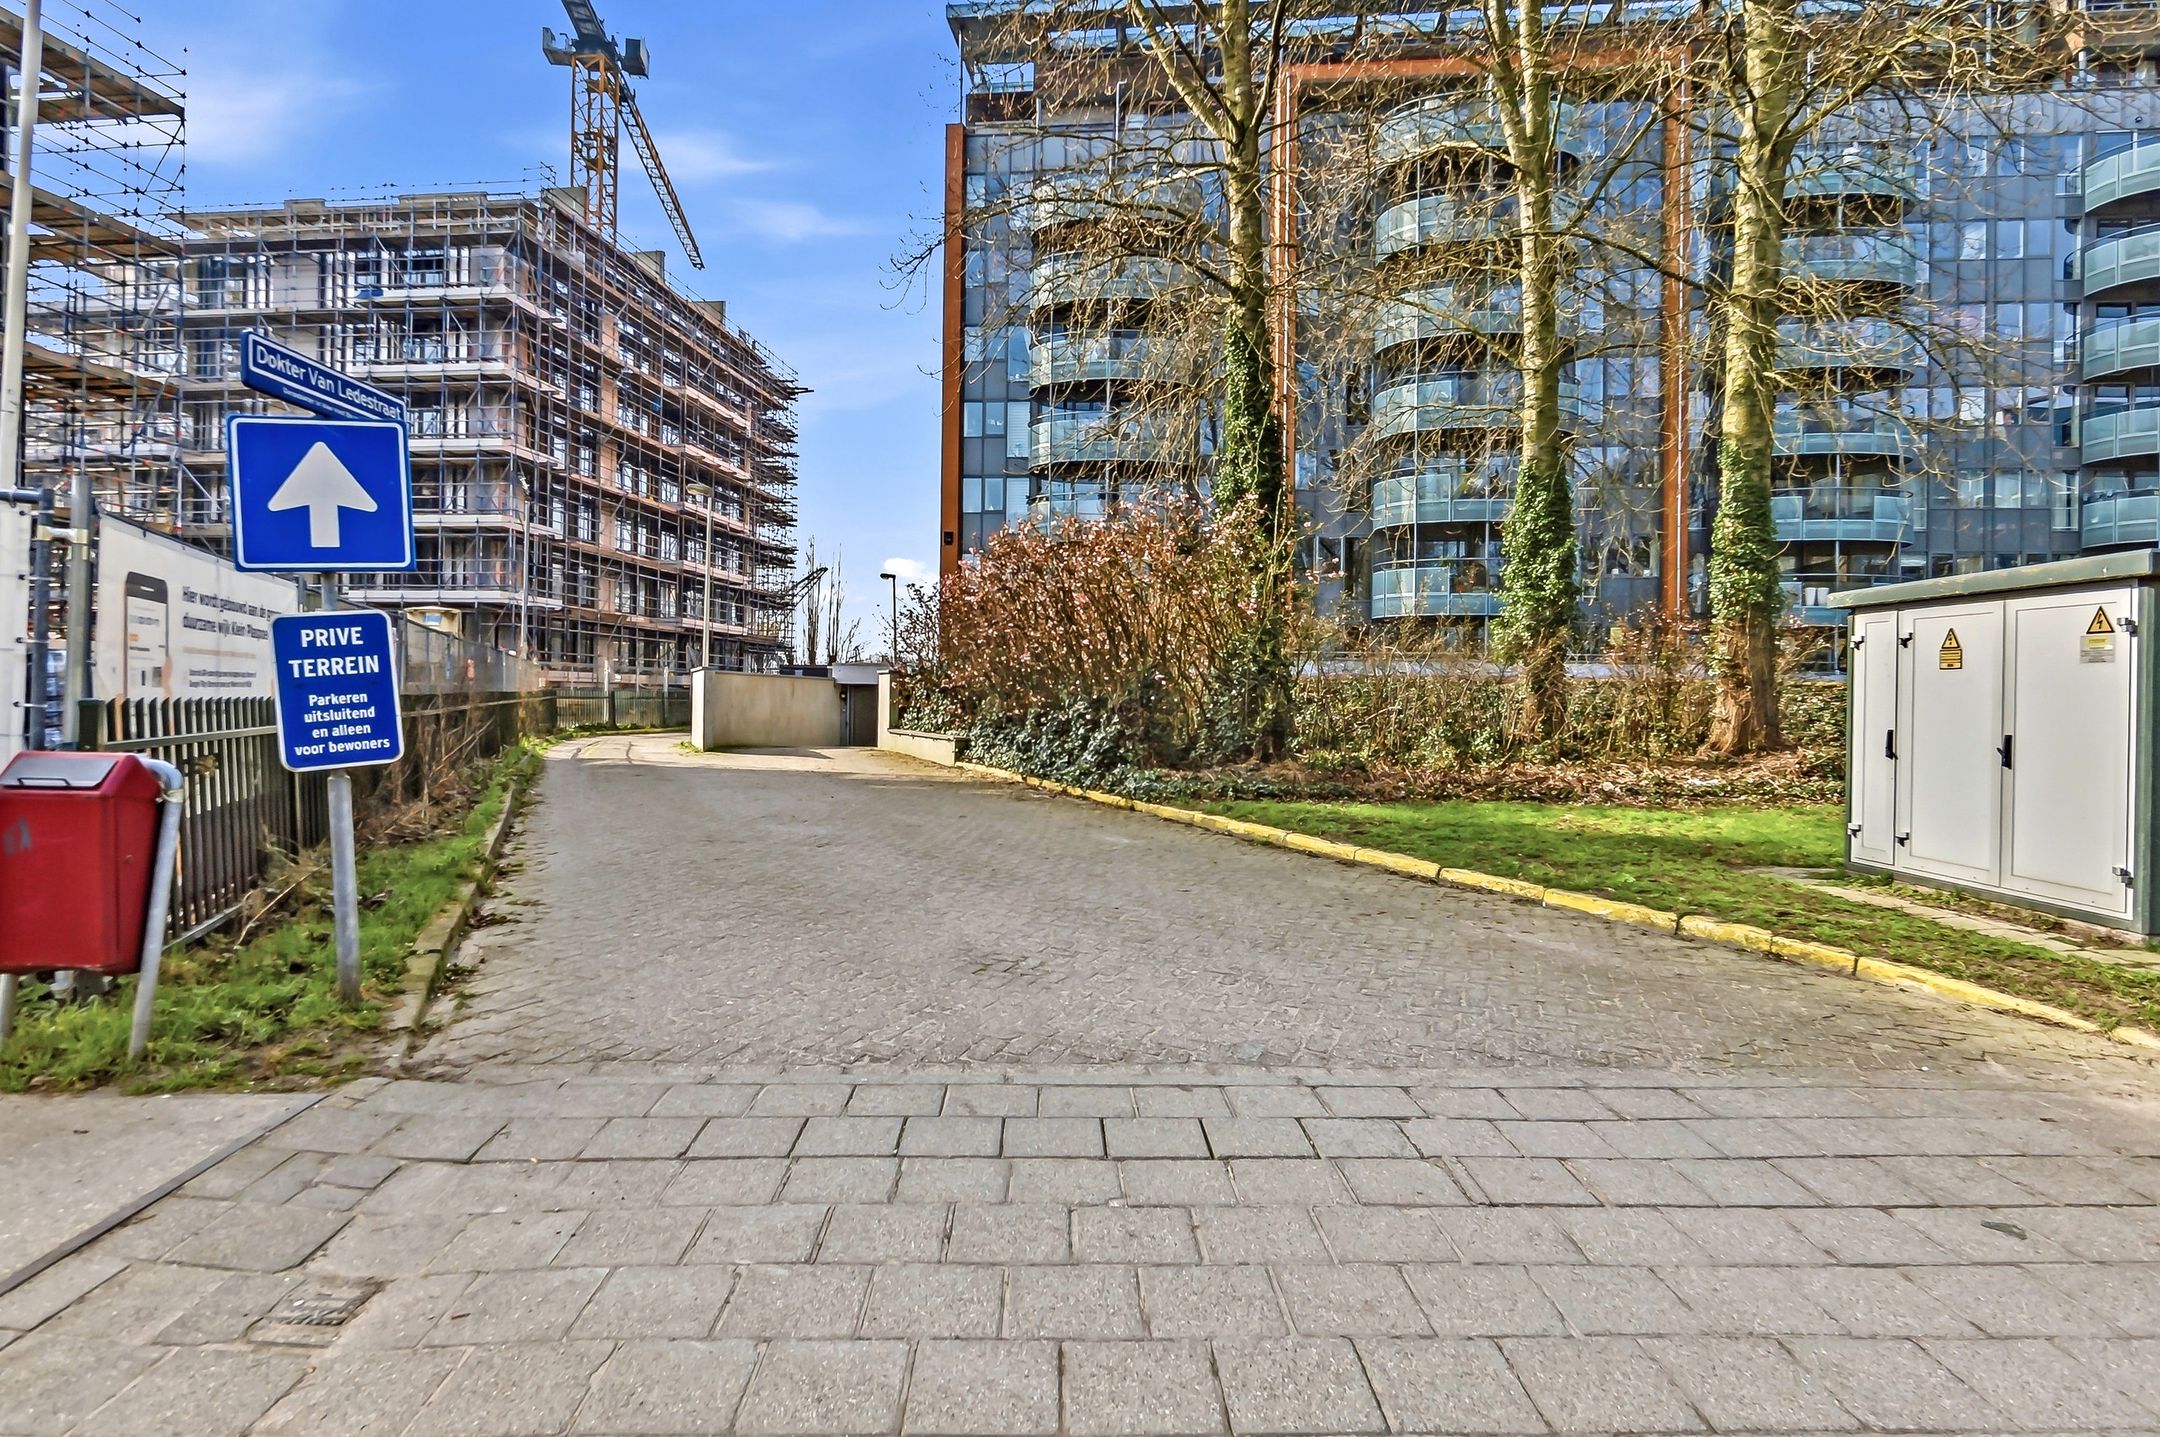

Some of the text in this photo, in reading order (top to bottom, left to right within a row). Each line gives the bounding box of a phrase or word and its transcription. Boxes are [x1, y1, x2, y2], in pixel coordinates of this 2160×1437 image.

[256, 345, 306, 379] Dokter
[308, 367, 335, 393] Van
[338, 380, 401, 420] Ledestraat
[300, 627, 364, 648] PRIVE
[288, 655, 380, 678] TERREIN
[308, 693, 368, 707] Parkeren
[303, 706, 376, 723] uitsluitend
[312, 724, 371, 738] en alleen
[294, 738, 390, 756] voor bewoners
